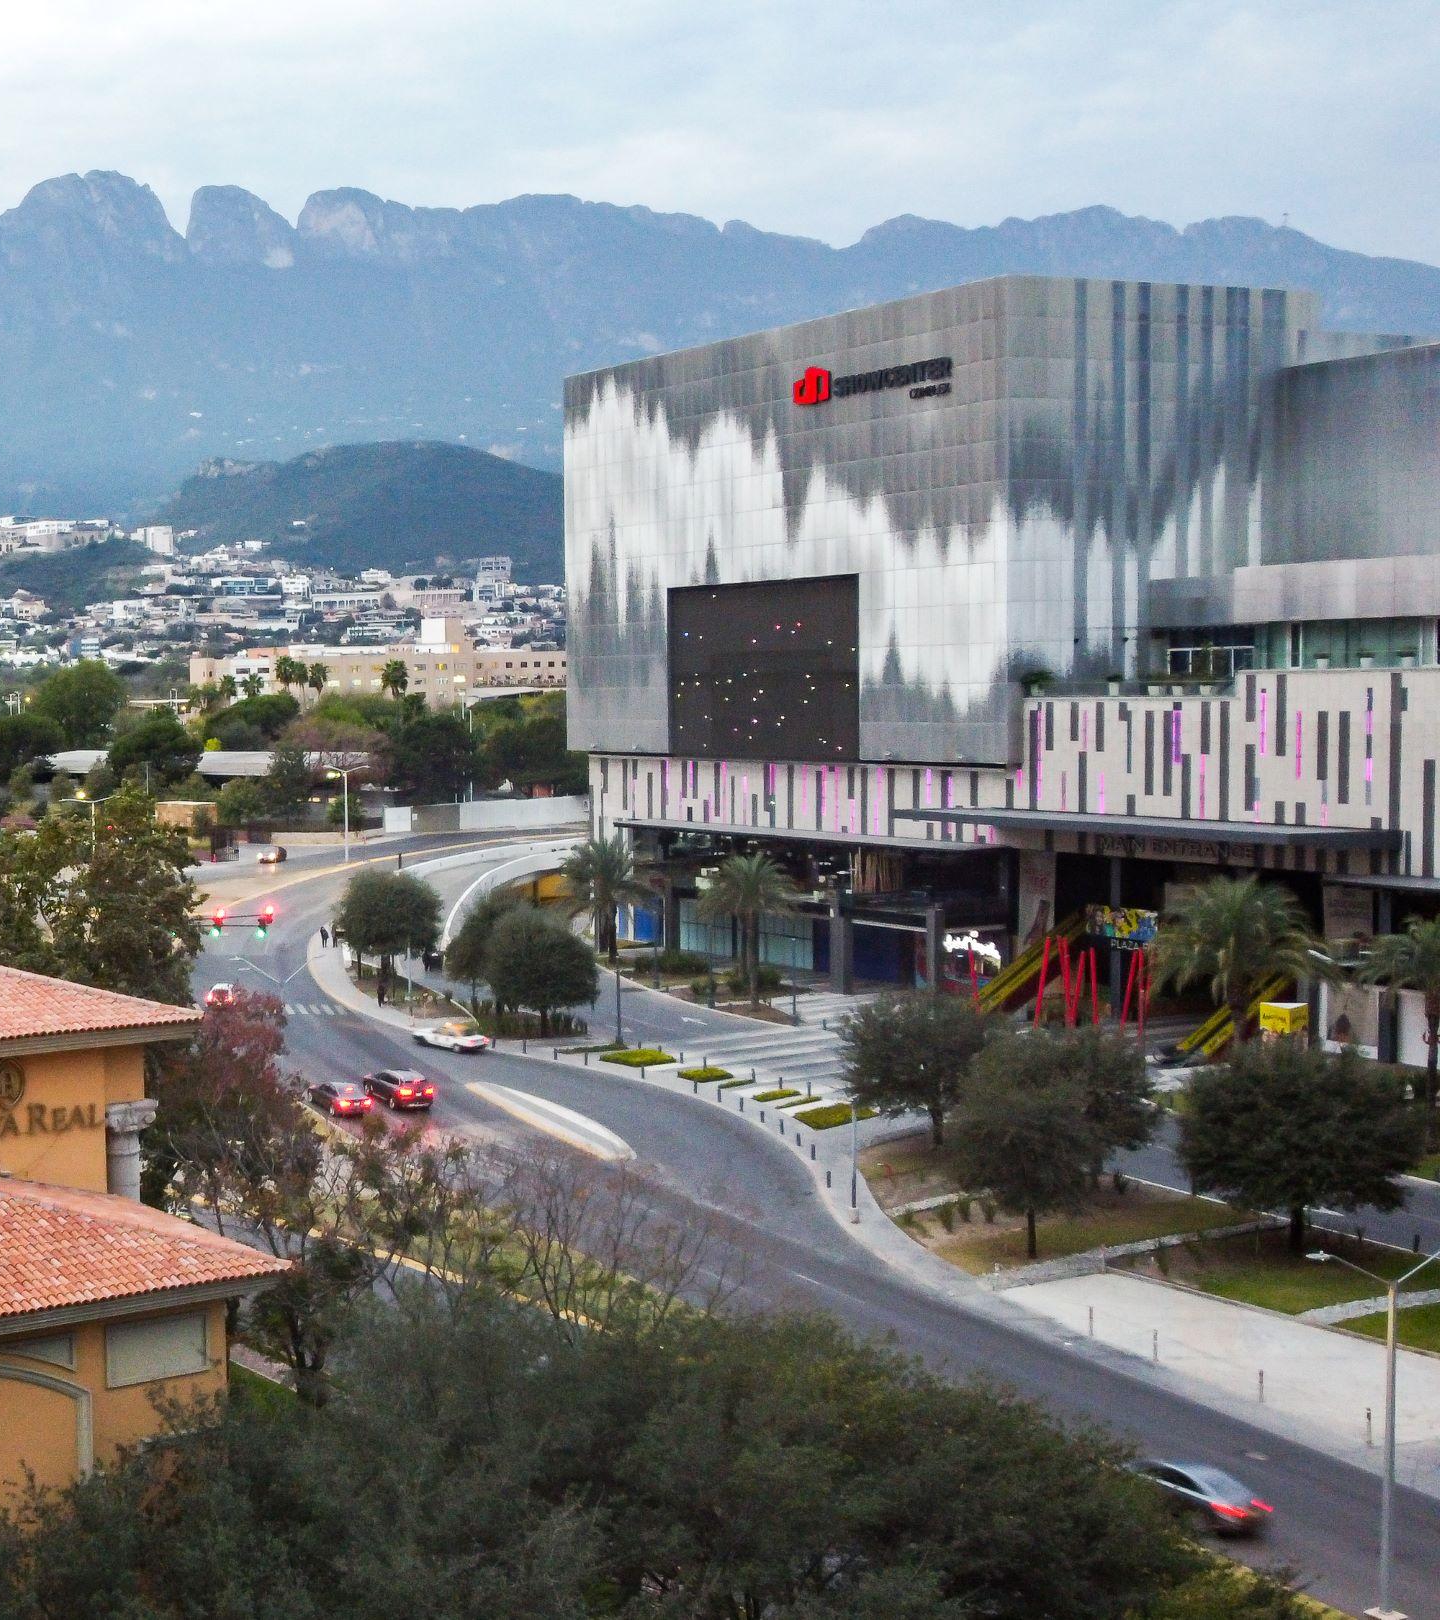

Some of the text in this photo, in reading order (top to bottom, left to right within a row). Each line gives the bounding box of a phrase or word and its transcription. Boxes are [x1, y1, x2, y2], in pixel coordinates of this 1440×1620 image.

[1100, 837, 1254, 859] MAIN ENTRANCE
[27, 1103, 104, 1136] REAL
